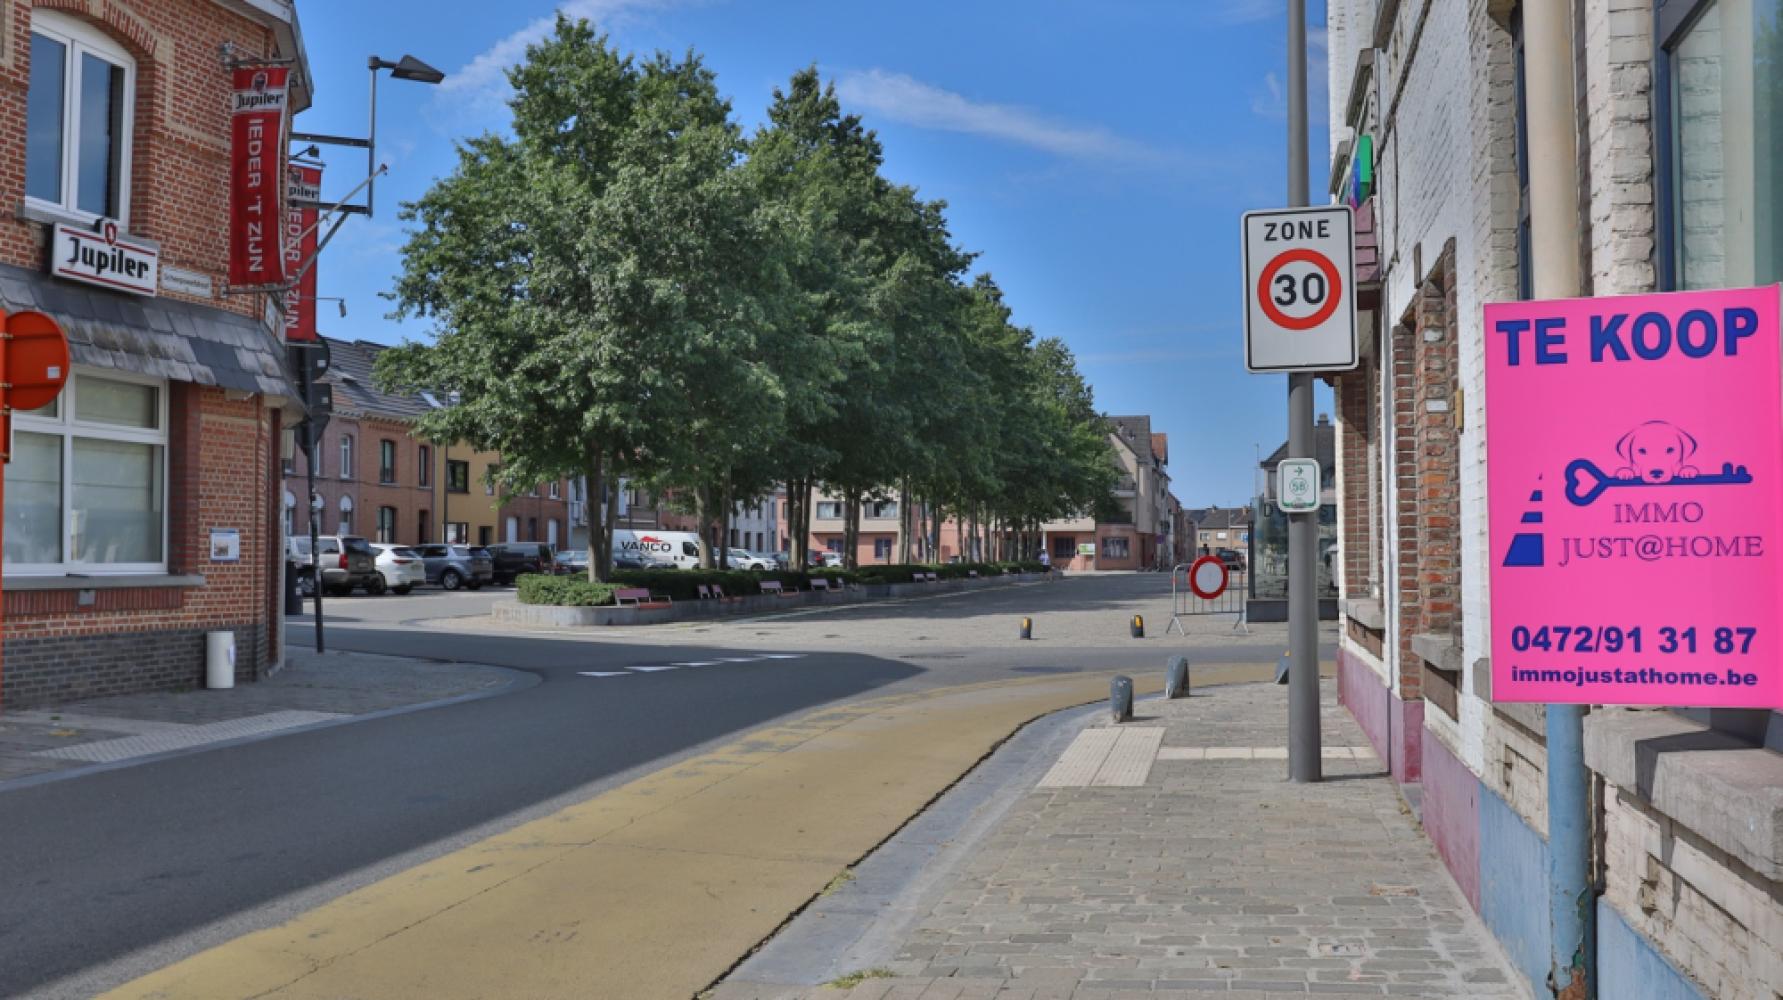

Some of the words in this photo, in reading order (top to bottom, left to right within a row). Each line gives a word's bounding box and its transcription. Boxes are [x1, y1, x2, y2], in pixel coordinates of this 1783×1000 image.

[236, 92, 283, 109] Jupiler
[247, 119, 264, 188] IEDER
[288, 185, 320, 199] piler
[1264, 219, 1330, 241] ZONE
[66, 236, 149, 279] Jupiler
[247, 222, 264, 272] ZIJN
[1274, 272, 1326, 306] 30
[1496, 317, 1568, 366] TE
[1590, 307, 1759, 362] KOOP
[1613, 502, 1704, 523] IMMO
[621, 541, 671, 552] VANCO
[1558, 535, 1764, 567] JUST@HOME
[1511, 625, 1642, 653] 0472/91
[1658, 626, 1697, 654] 31
[1713, 626, 1757, 655] 87
[1511, 666, 1758, 687] immojustathome.be
